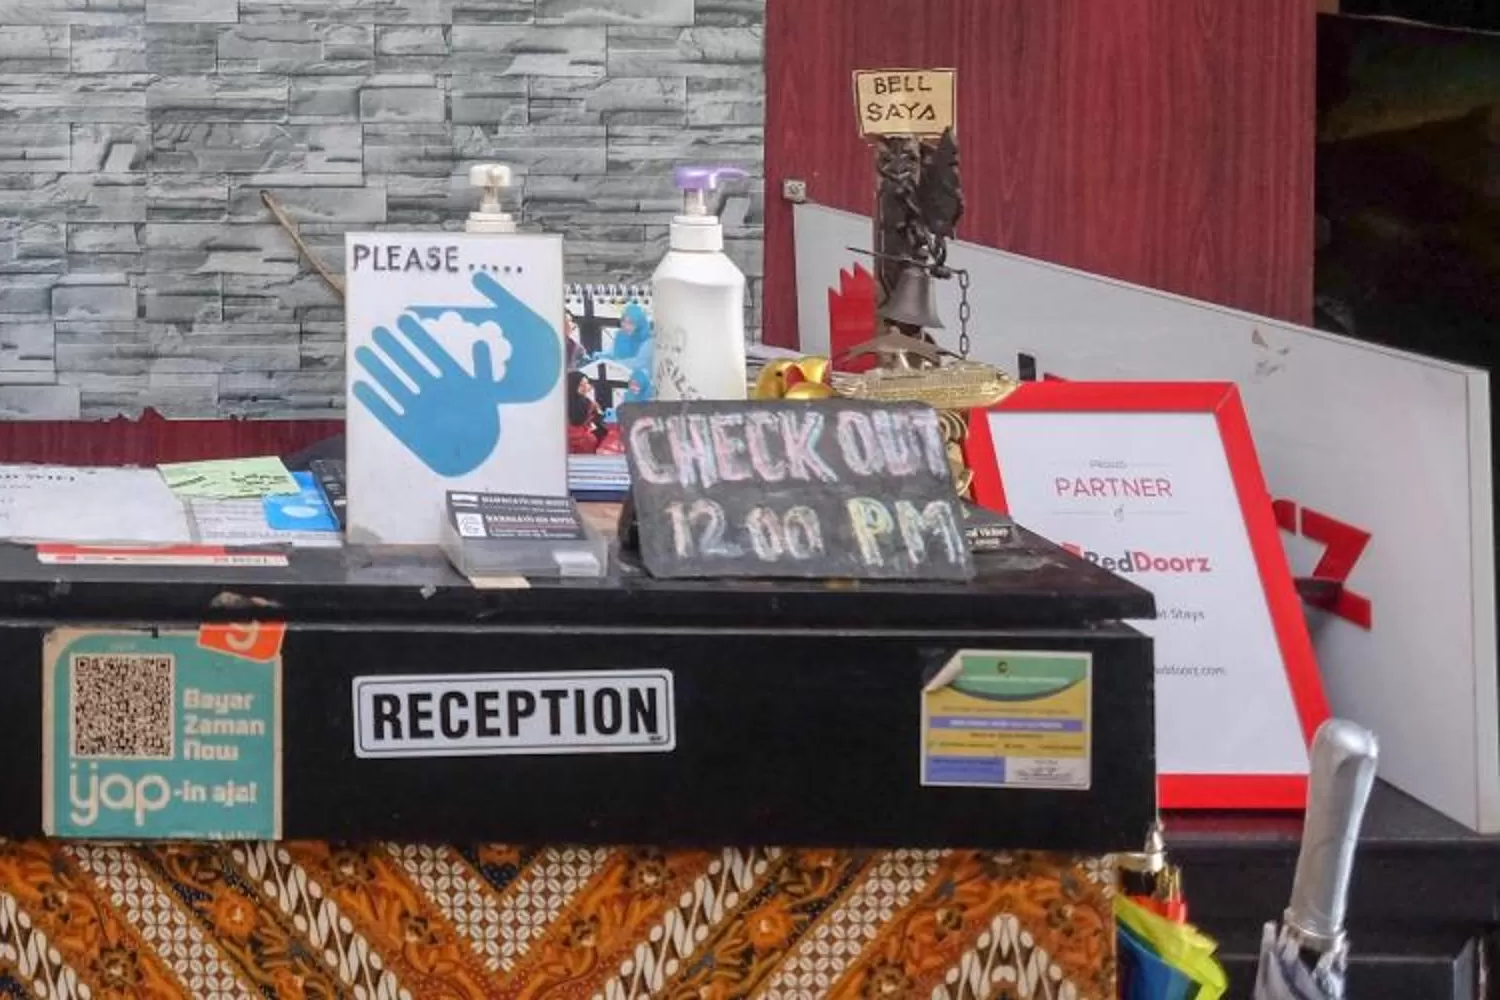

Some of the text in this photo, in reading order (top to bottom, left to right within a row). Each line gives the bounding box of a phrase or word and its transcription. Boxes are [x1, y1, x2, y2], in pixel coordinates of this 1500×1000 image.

[874, 75, 932, 95] BELL
[867, 102, 936, 122] SAYA
[629, 407, 948, 489] CHECK OUT
[1054, 476, 1173, 498] PARTNER
[847, 496, 967, 569] PM
[183, 688, 255, 714] Bayar
[183, 714, 266, 736] Zaman
[371, 687, 659, 741] RECEPTION
